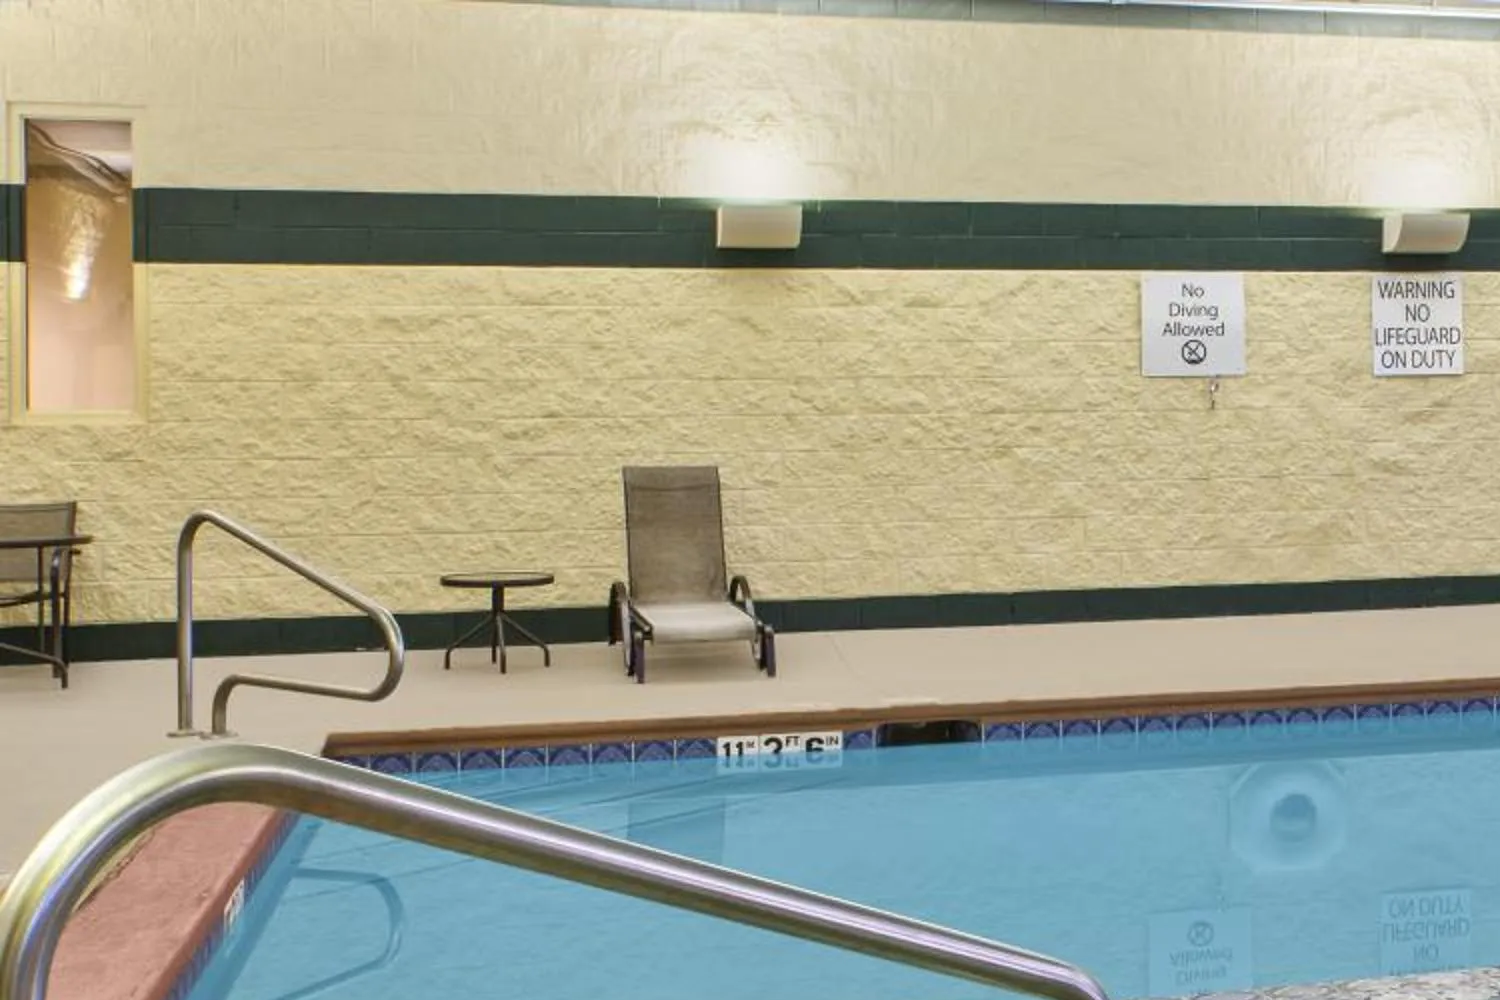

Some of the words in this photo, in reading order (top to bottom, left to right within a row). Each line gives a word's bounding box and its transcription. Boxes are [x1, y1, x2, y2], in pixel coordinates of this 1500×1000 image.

[1181, 283, 1205, 298] No
[1377, 280, 1455, 299] WARNING
[1168, 302, 1219, 321] Diving
[1405, 303, 1431, 322] NO
[1161, 322, 1225, 337] Allowed
[1375, 327, 1461, 346] LIFEGUARD
[1381, 350, 1407, 369] ON
[1411, 349, 1456, 369] DUTY
